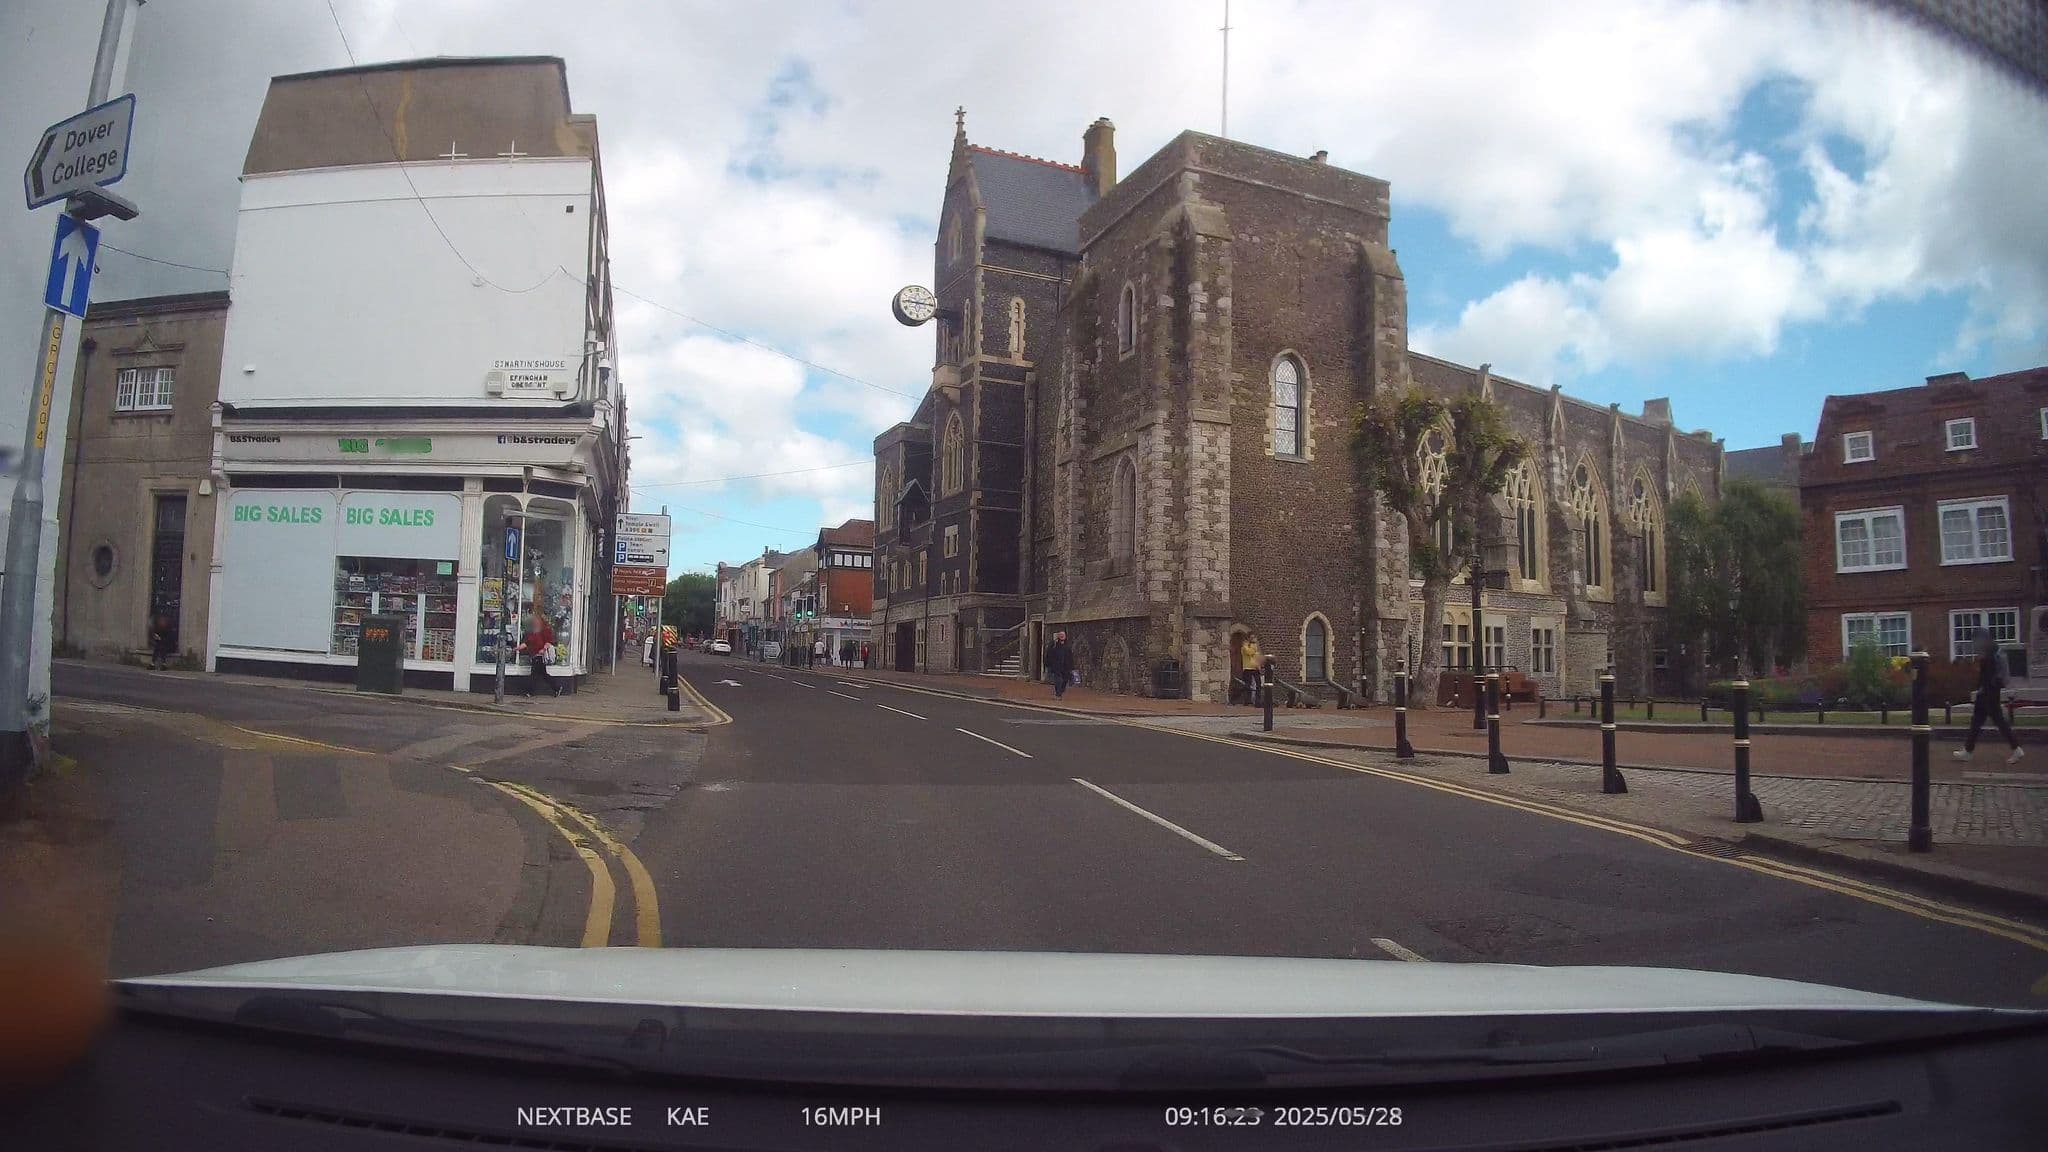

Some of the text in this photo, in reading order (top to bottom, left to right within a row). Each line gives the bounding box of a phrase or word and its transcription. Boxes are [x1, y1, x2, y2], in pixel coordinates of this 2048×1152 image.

[64, 120, 115, 153] Dover
[52, 149, 118, 185] College
[234, 505, 323, 523] BIG SALES
[346, 508, 435, 527] BIG SALES
